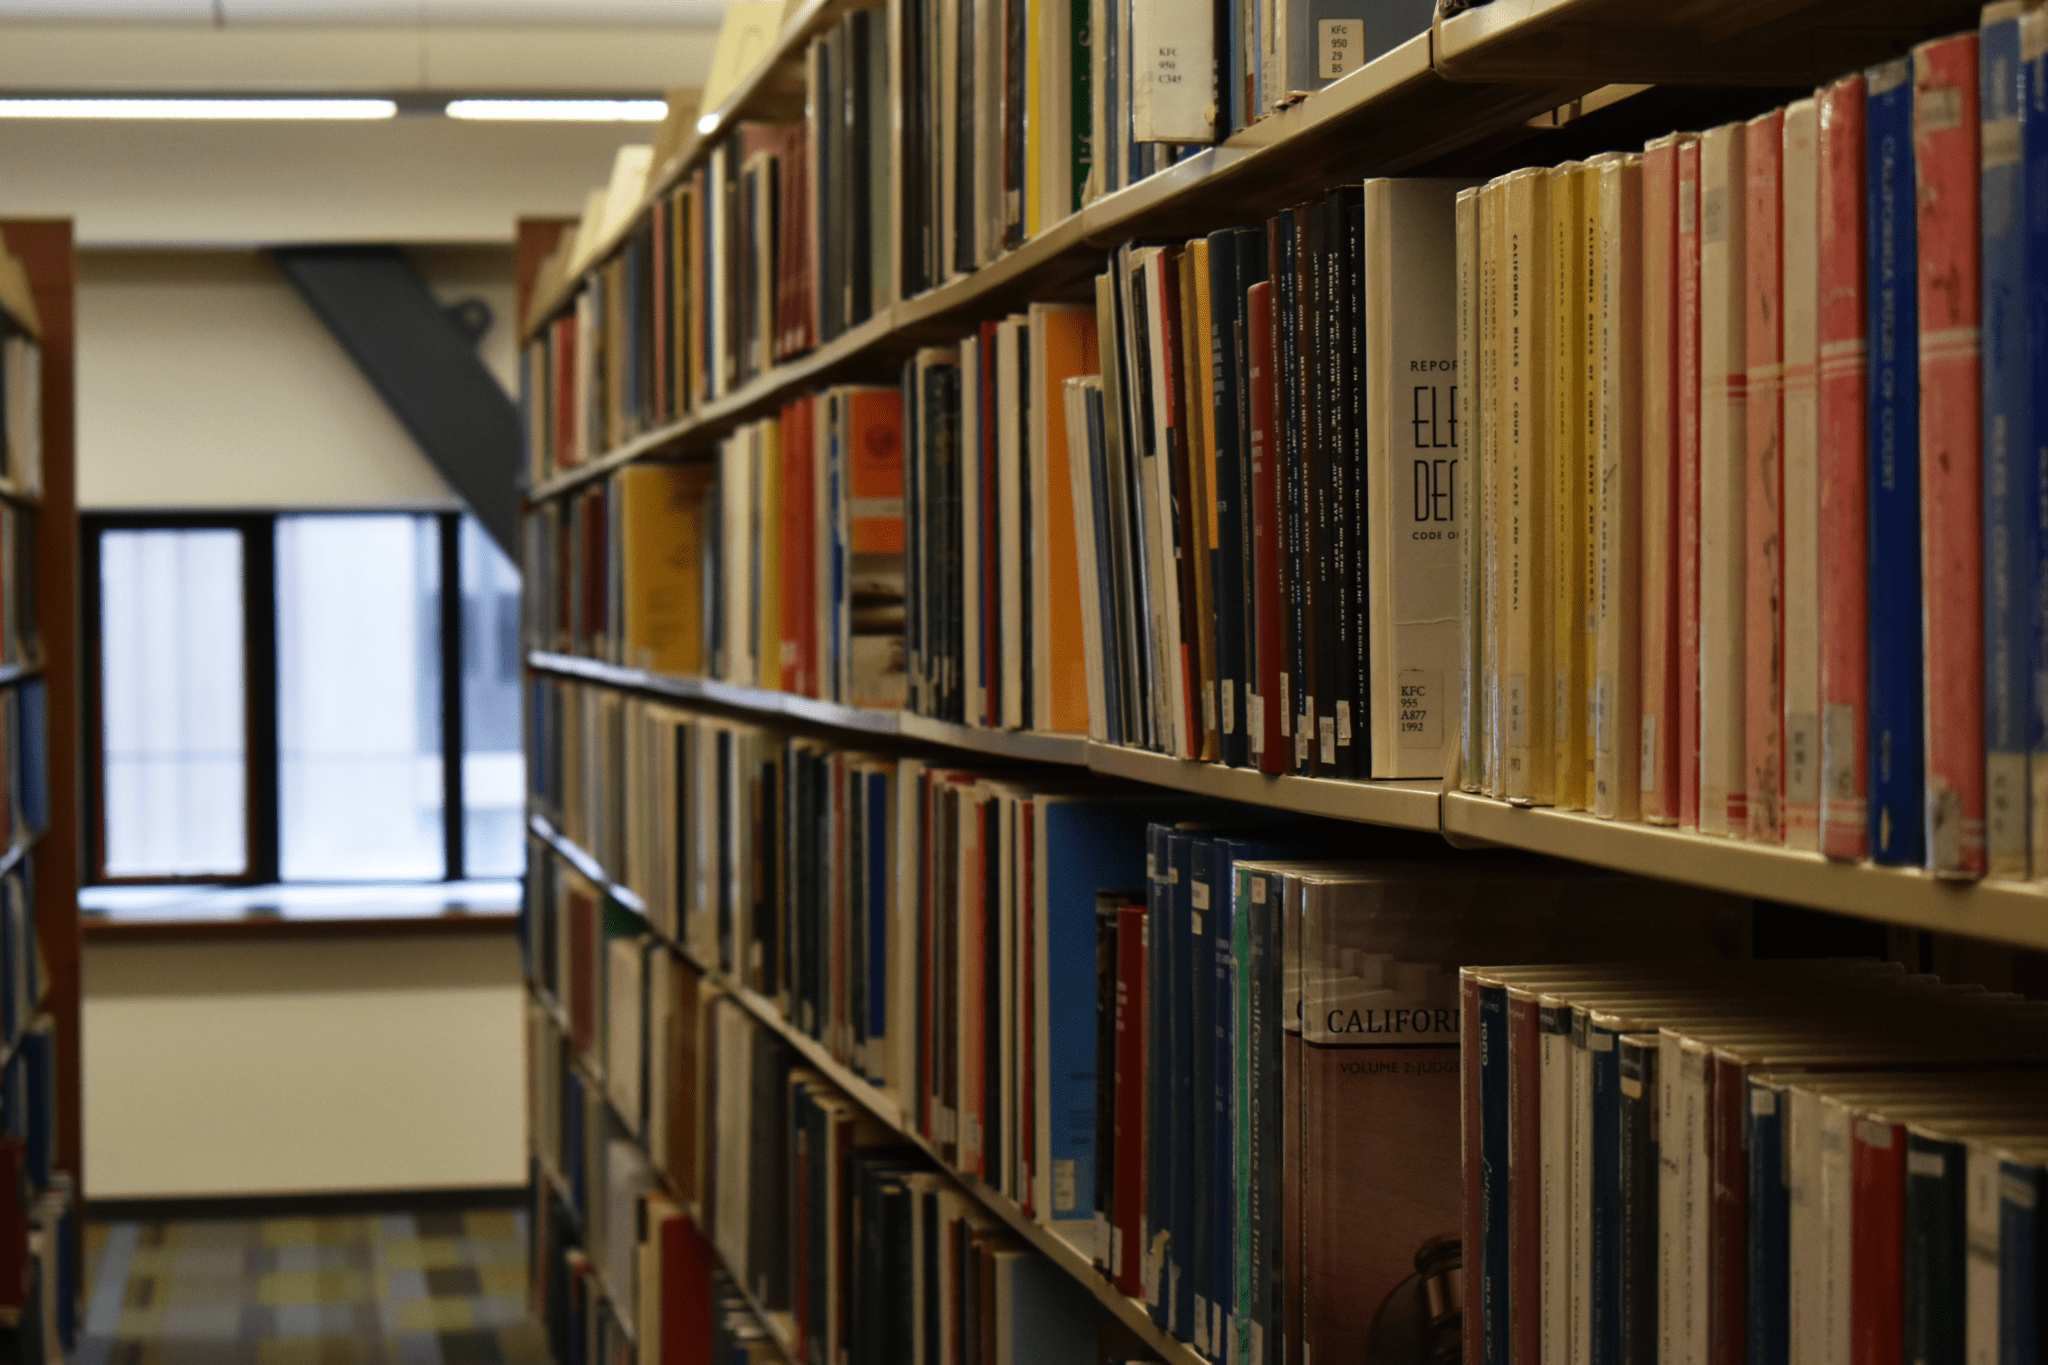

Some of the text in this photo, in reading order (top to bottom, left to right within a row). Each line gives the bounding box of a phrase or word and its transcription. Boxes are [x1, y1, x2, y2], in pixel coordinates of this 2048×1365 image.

[1331, 25, 1347, 34] KFC
[1331, 39, 1347, 48] 950
[1331, 51, 1342, 61] Z9
[1331, 64, 1343, 73] B5
[1351, 272, 1356, 285] TO
[1335, 299, 1340, 312] TO
[1329, 309, 1334, 321] IN
[1316, 363, 1321, 376] OF
[1353, 367, 1358, 381] ON
[1589, 365, 1594, 381] OF
[1513, 376, 1519, 392] OF
[1331, 389, 1336, 401] TO
[1337, 406, 1342, 420] ON
[1293, 467, 1298, 479] ON
[1354, 468, 1360, 482] OF
[1338, 507, 1344, 520] OF
[1412, 531, 1442, 541] CODE
[1400, 686, 1426, 696] KFC
[1400, 698, 1418, 708] 955
[1400, 710, 1427, 720] A877
[1401, 722, 1424, 732] 1992
[1481, 1020, 1489, 1066] 1989
[1340, 1061, 1398, 1074] VOLUME
[1251, 979, 1262, 1303] California Courts and Judges
